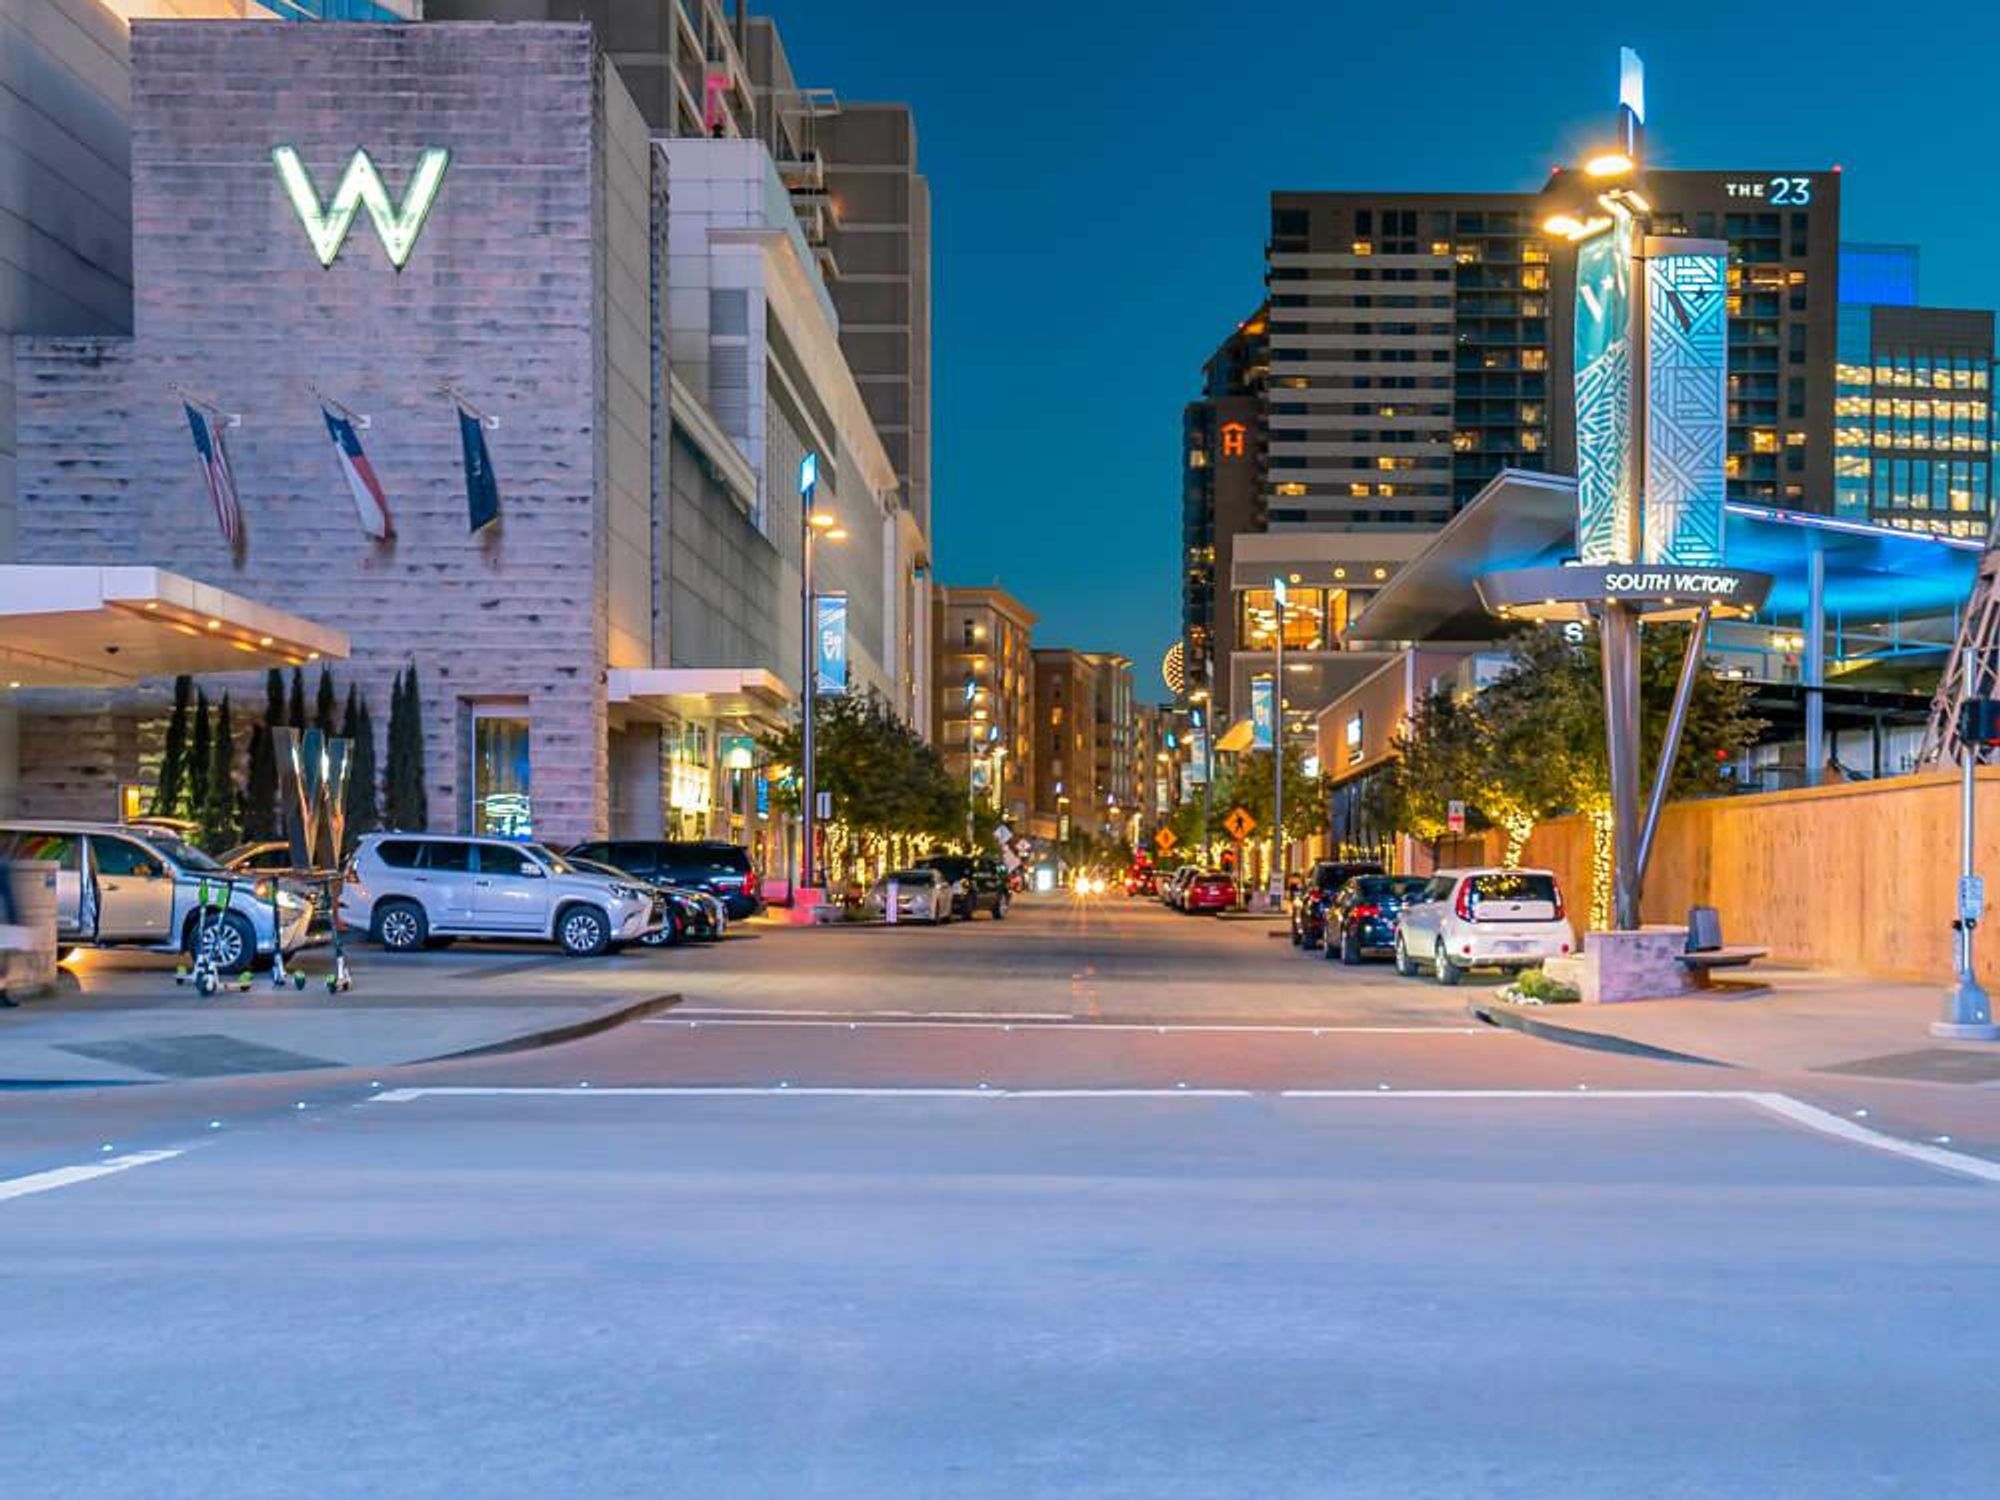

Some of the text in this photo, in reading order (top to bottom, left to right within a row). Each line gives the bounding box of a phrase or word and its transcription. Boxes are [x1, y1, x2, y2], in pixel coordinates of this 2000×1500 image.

[1726, 177, 1810, 205] THE 23
[272, 145, 450, 271] W
[1605, 573, 1739, 593] SOUTH VICTORY
